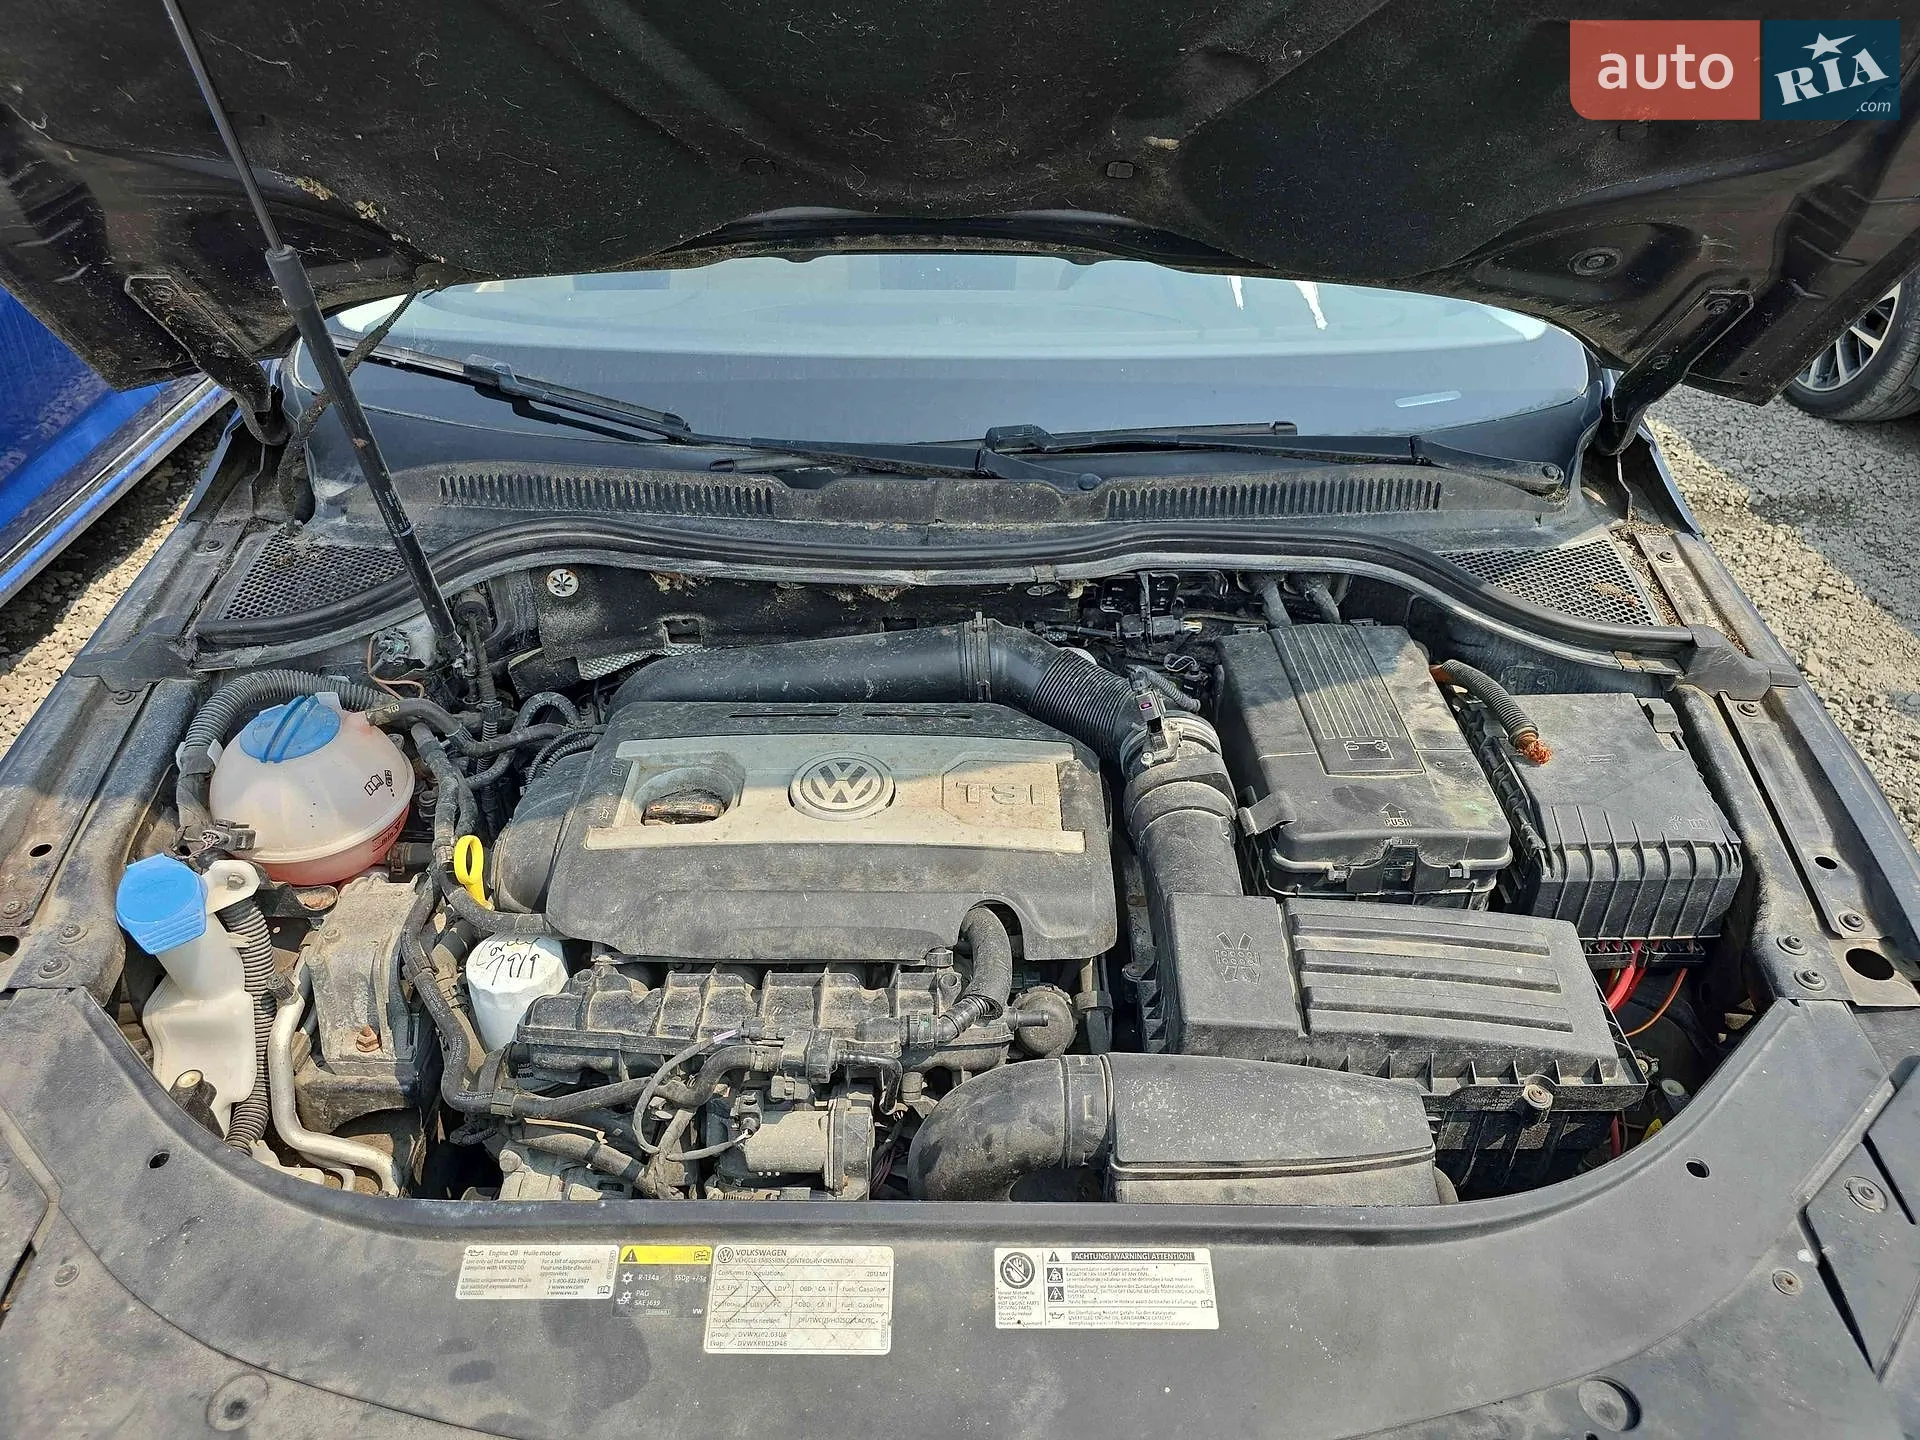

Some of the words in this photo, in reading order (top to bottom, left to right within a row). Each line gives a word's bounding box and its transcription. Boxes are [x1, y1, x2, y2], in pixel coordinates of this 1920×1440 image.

[956, 782, 1045, 806] TSI
[1384, 818, 1412, 827] PUSH
[488, 1250, 508, 1258] Engine
[509, 1250, 518, 1258] Oil
[524, 1250, 538, 1258] Huile
[539, 1250, 562, 1258] moteur
